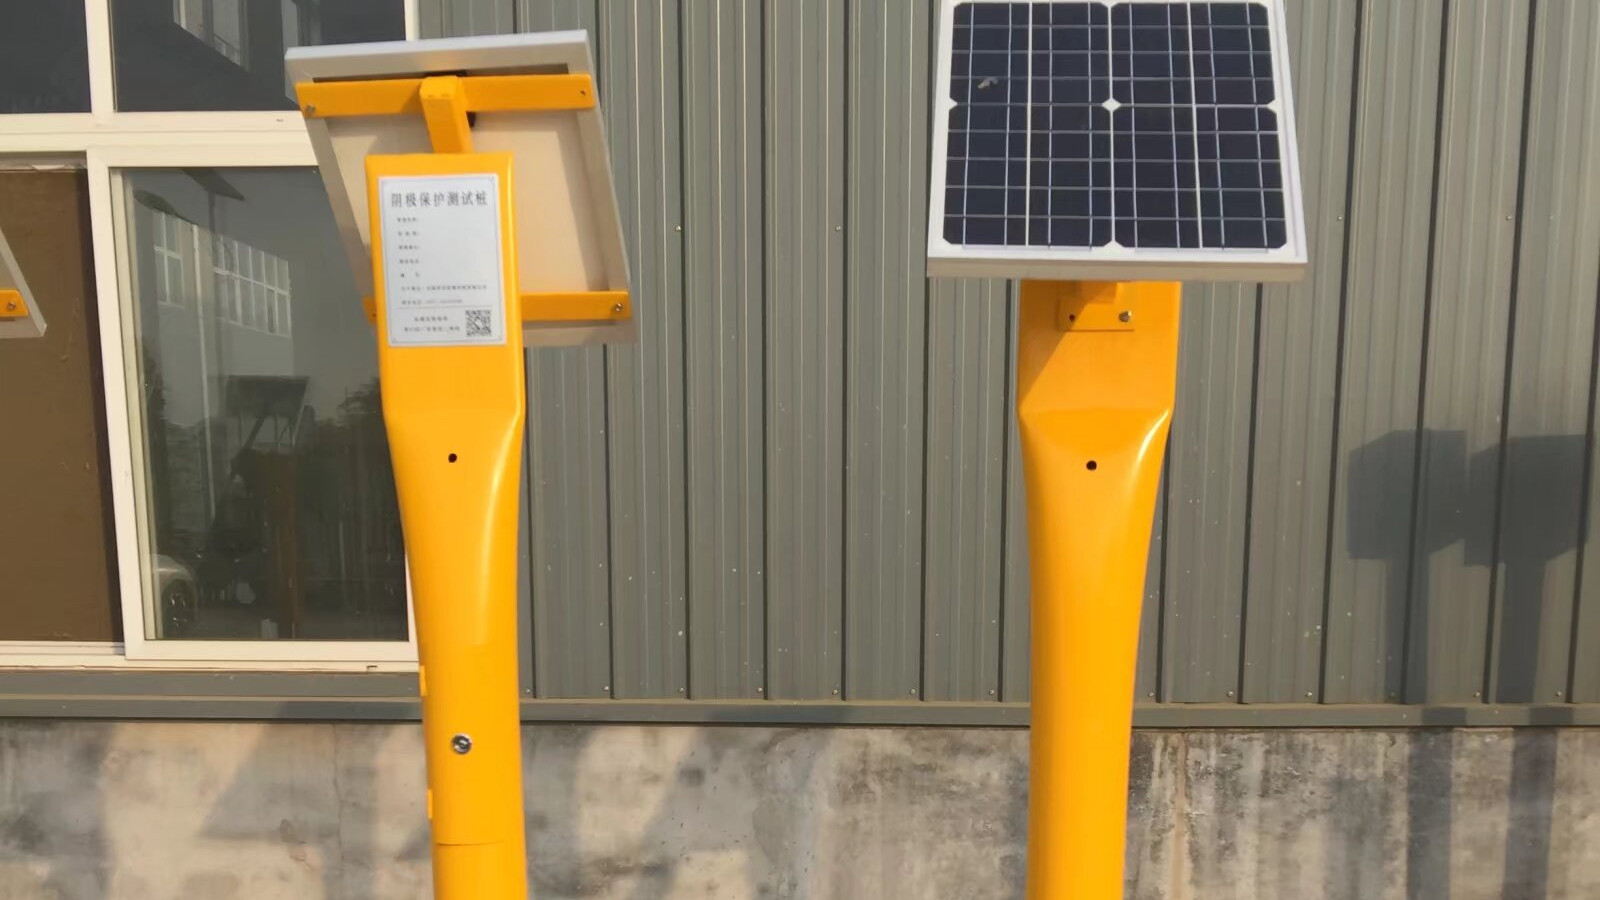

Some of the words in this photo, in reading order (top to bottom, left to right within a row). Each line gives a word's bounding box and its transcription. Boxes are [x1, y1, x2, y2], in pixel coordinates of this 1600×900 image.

[391, 190, 488, 207] 阴极保护测试桩
